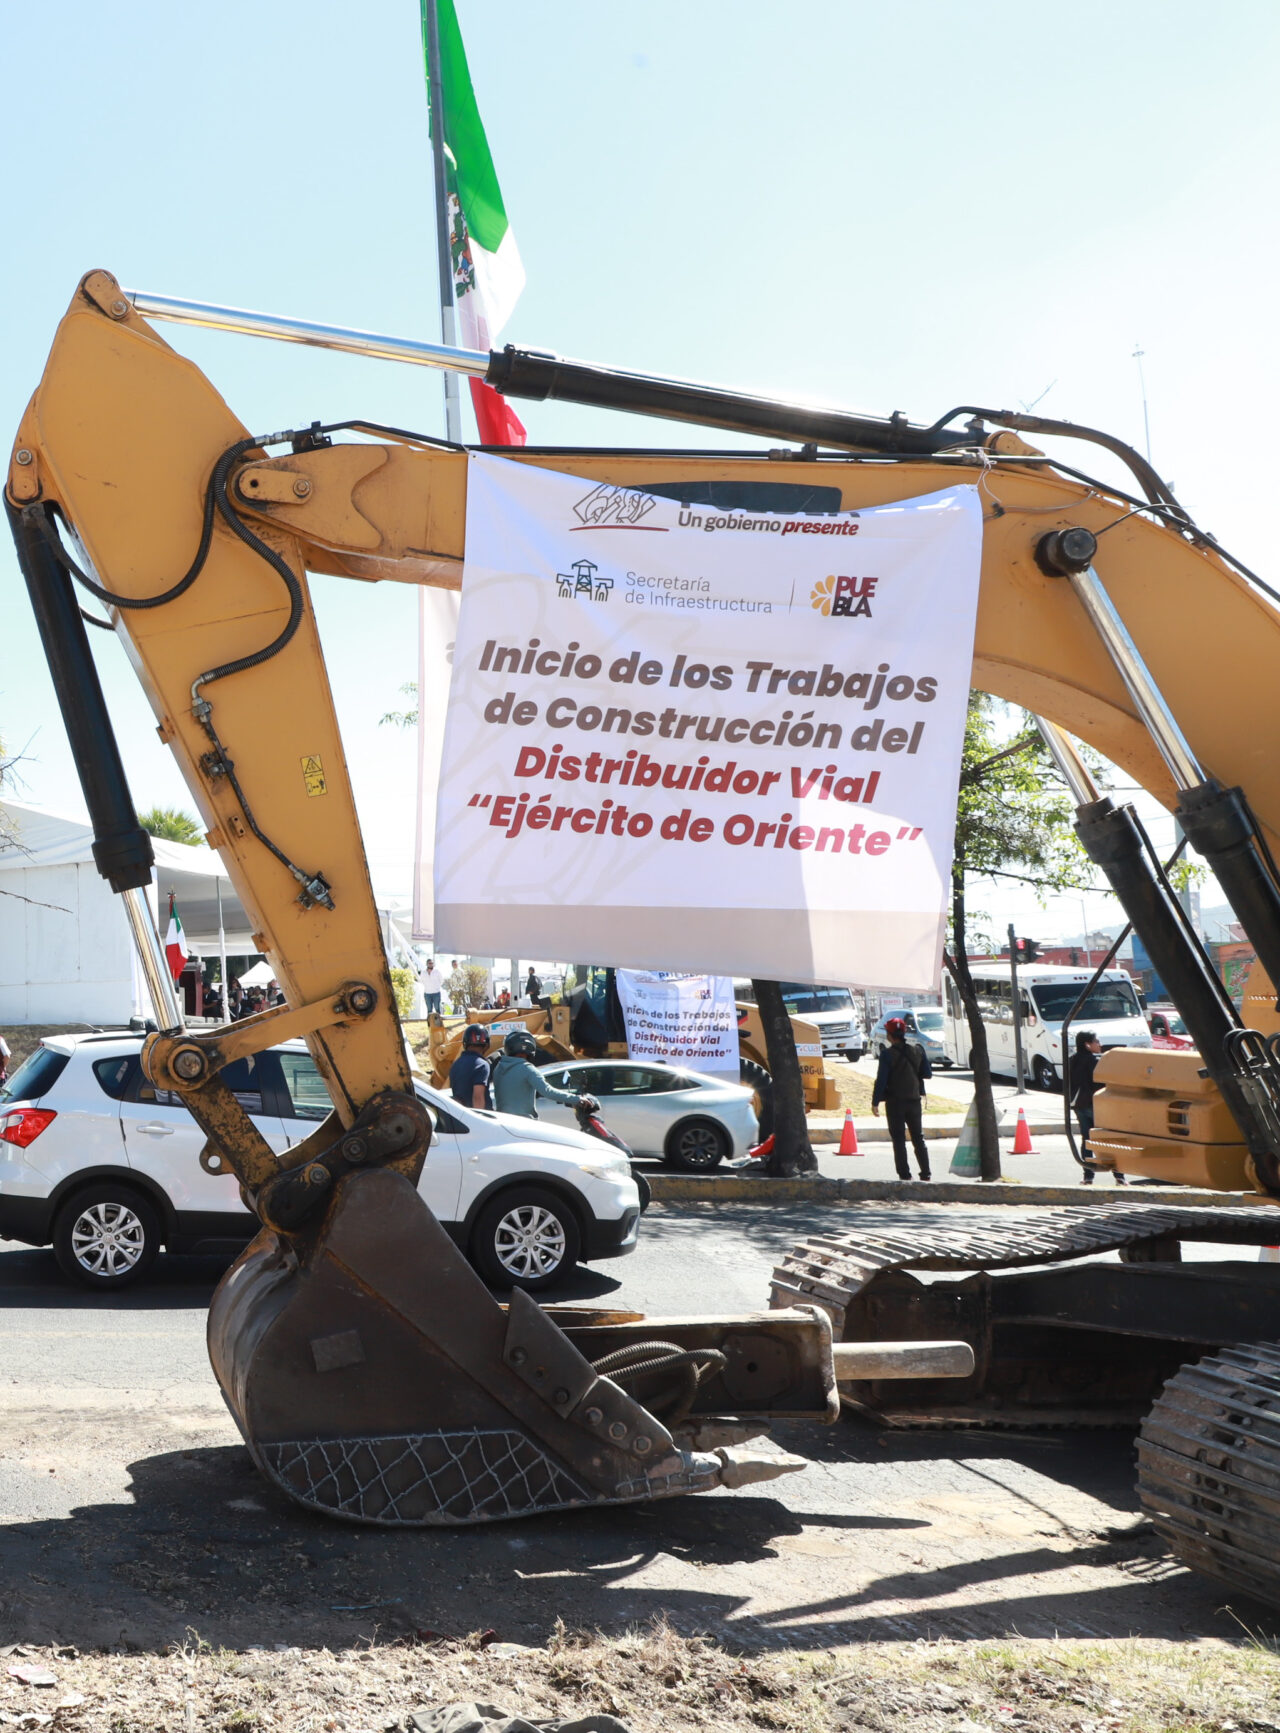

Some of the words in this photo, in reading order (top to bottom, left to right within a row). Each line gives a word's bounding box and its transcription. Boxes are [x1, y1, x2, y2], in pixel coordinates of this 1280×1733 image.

[678, 511, 703, 528] Un
[704, 513, 782, 533] gobierno
[781, 520, 860, 536] presente
[625, 571, 711, 593] Secretaría
[835, 575, 879, 598] PUE
[624, 589, 645, 605] de
[649, 591, 773, 614] Infraestructura
[831, 596, 873, 618] BLA
[478, 638, 602, 680] Inicio
[608, 651, 664, 686] de
[669, 654, 734, 691] los
[745, 661, 939, 711] Trabajos
[483, 691, 538, 726] de
[545, 697, 843, 750] Construcción
[850, 718, 925, 755] del
[513, 743, 782, 796] Distribuidor
[790, 764, 881, 804] Vial
[660, 808, 715, 843] de
[627, 1019, 637, 1027] de
[639, 1019, 711, 1032] Construcción
[712, 1023, 729, 1032] del
[650, 1010, 663, 1019] de
[664, 1010, 680, 1020] los
[682, 1009, 731, 1021] Trabajos
[634, 1032, 698, 1044] Distribuidor
[700, 1035, 720, 1045] Vial
[670, 1046, 683, 1056] de
